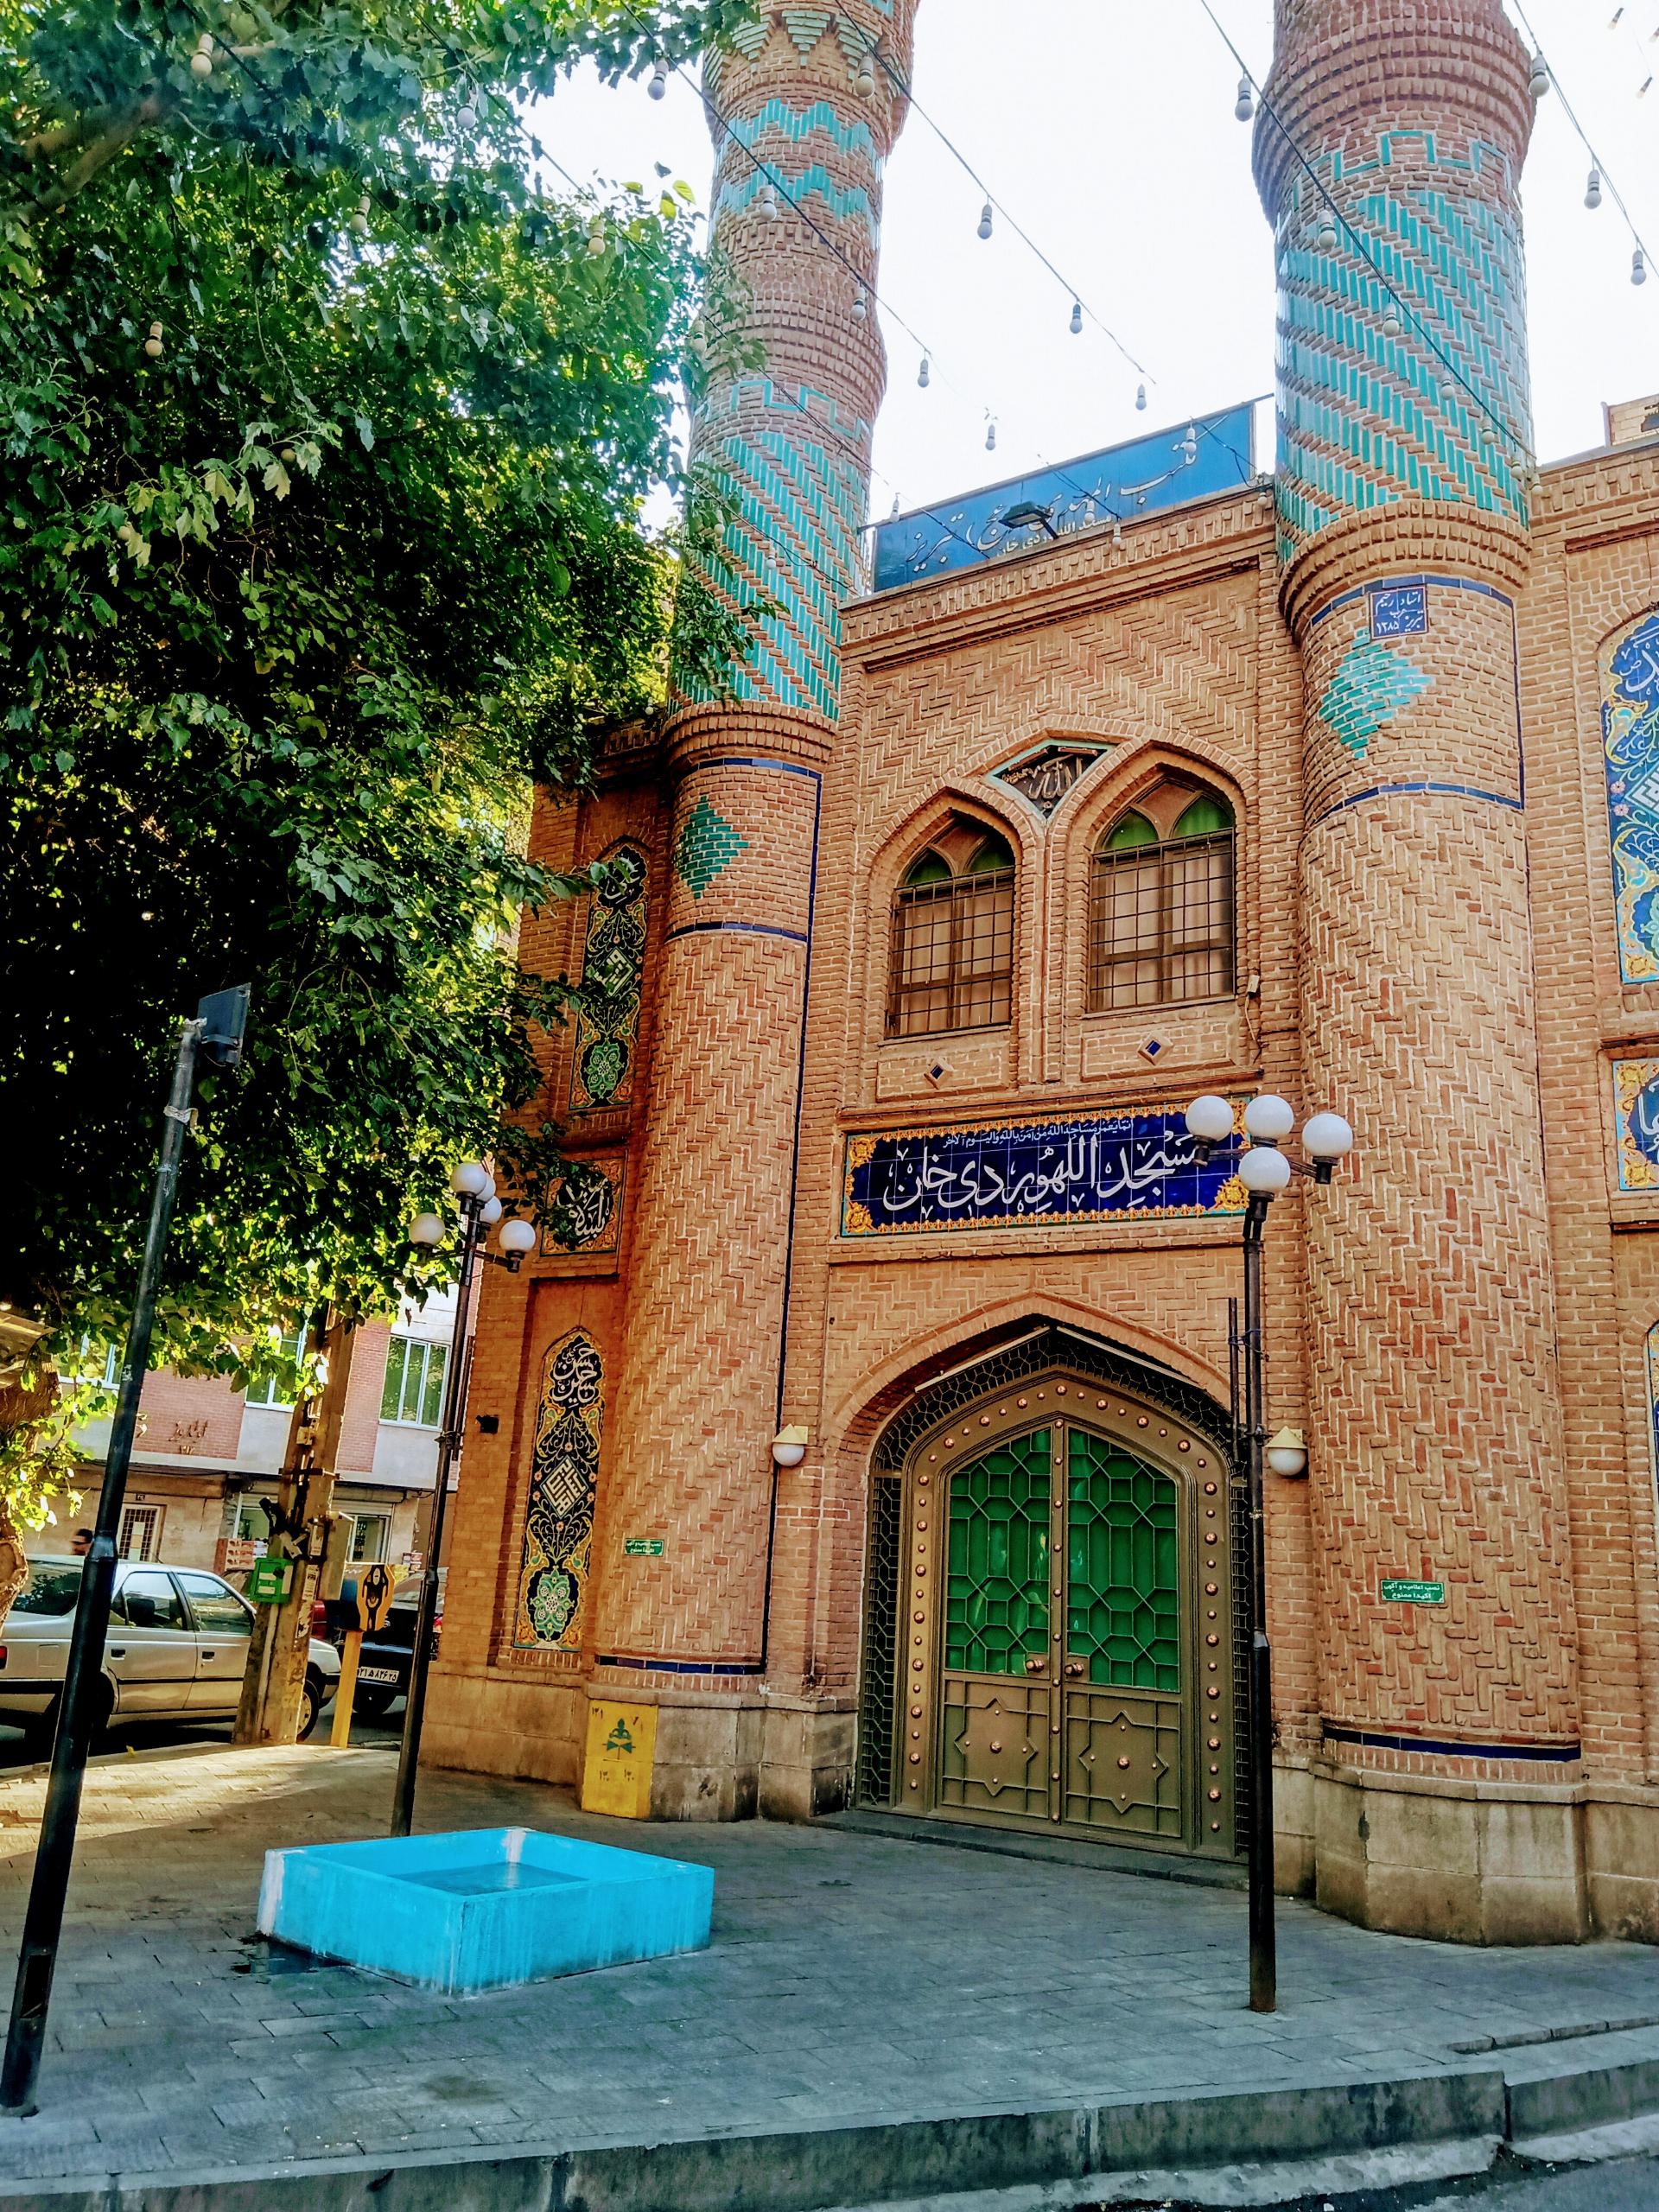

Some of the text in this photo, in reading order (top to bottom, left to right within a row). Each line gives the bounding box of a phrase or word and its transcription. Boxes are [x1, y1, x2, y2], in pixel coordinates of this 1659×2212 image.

[906, 512, 964, 572] تبریز
[1375, 590, 1421, 616] استاد رحیم
[1404, 610, 1424, 632] تبریز
[882, 1147, 958, 1213] خان
[1096, 1130, 1201, 1208] سجد
[1383, 1581, 1398, 1592] آگهی
